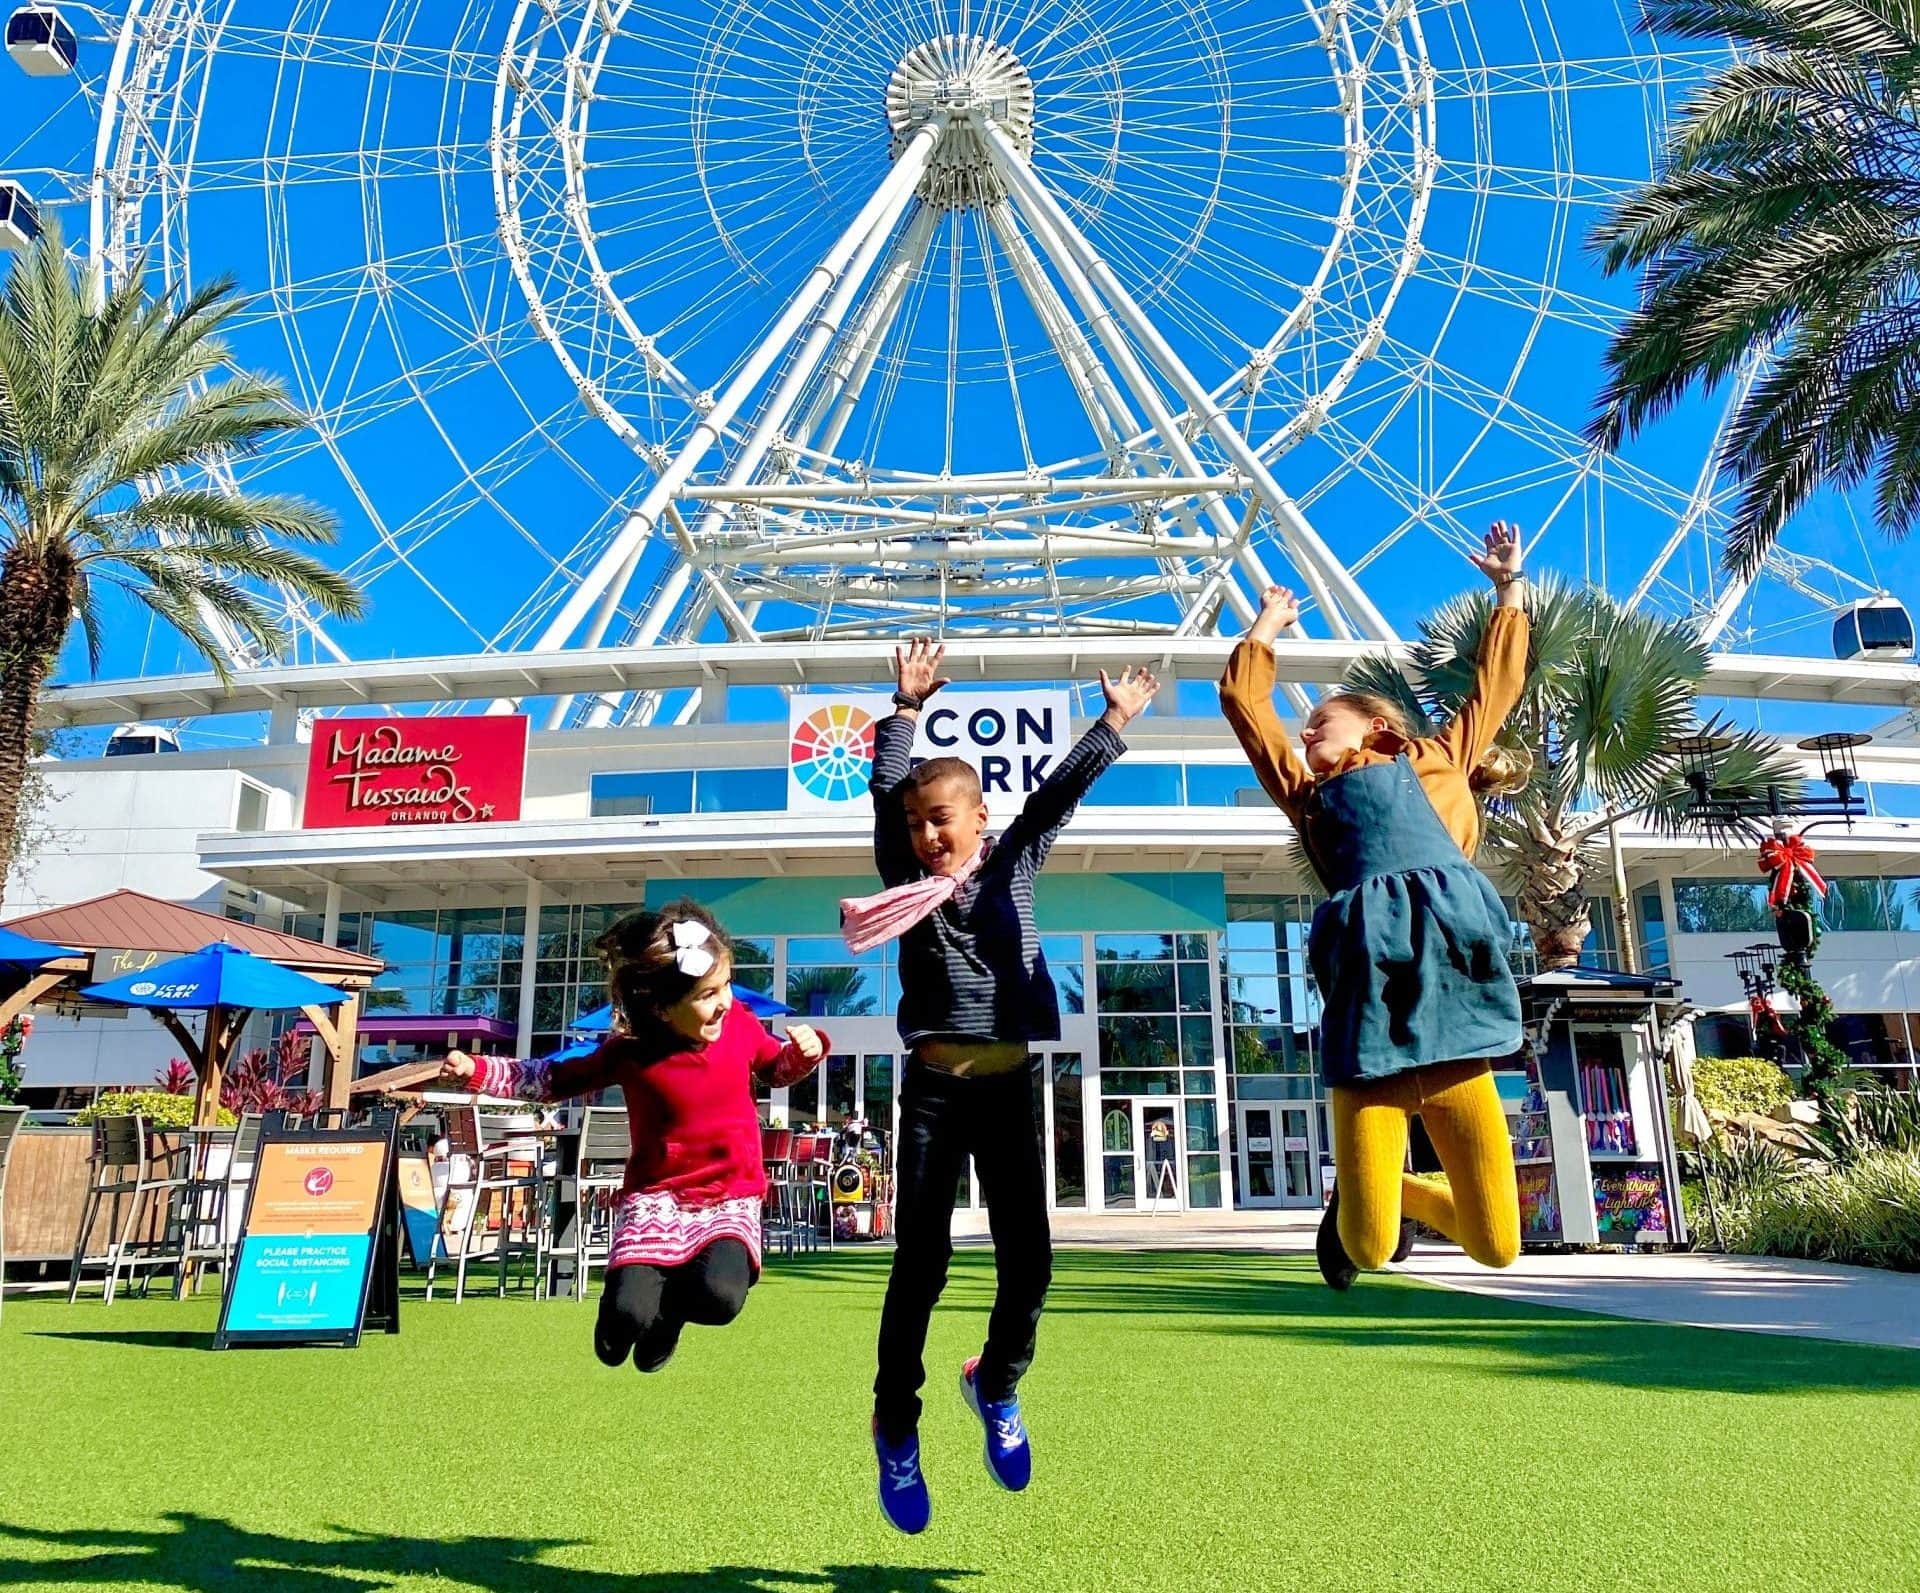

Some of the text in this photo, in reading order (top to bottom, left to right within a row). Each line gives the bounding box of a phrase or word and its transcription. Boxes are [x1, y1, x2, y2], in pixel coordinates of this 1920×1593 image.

[925, 707, 1054, 747] CON
[332, 726, 462, 769] Madame
[333, 765, 476, 822] Tussauds
[391, 810, 446, 822] ORLANDO
[111, 949, 135, 973] The
[160, 983, 200, 991] ICON
[153, 990, 193, 999] PARK
[1600, 1179, 1657, 1196] Everything
[263, 1246, 347, 1256] PLEASE PRACTICE
[256, 1257, 351, 1268] SOCIAL DISTANCING
